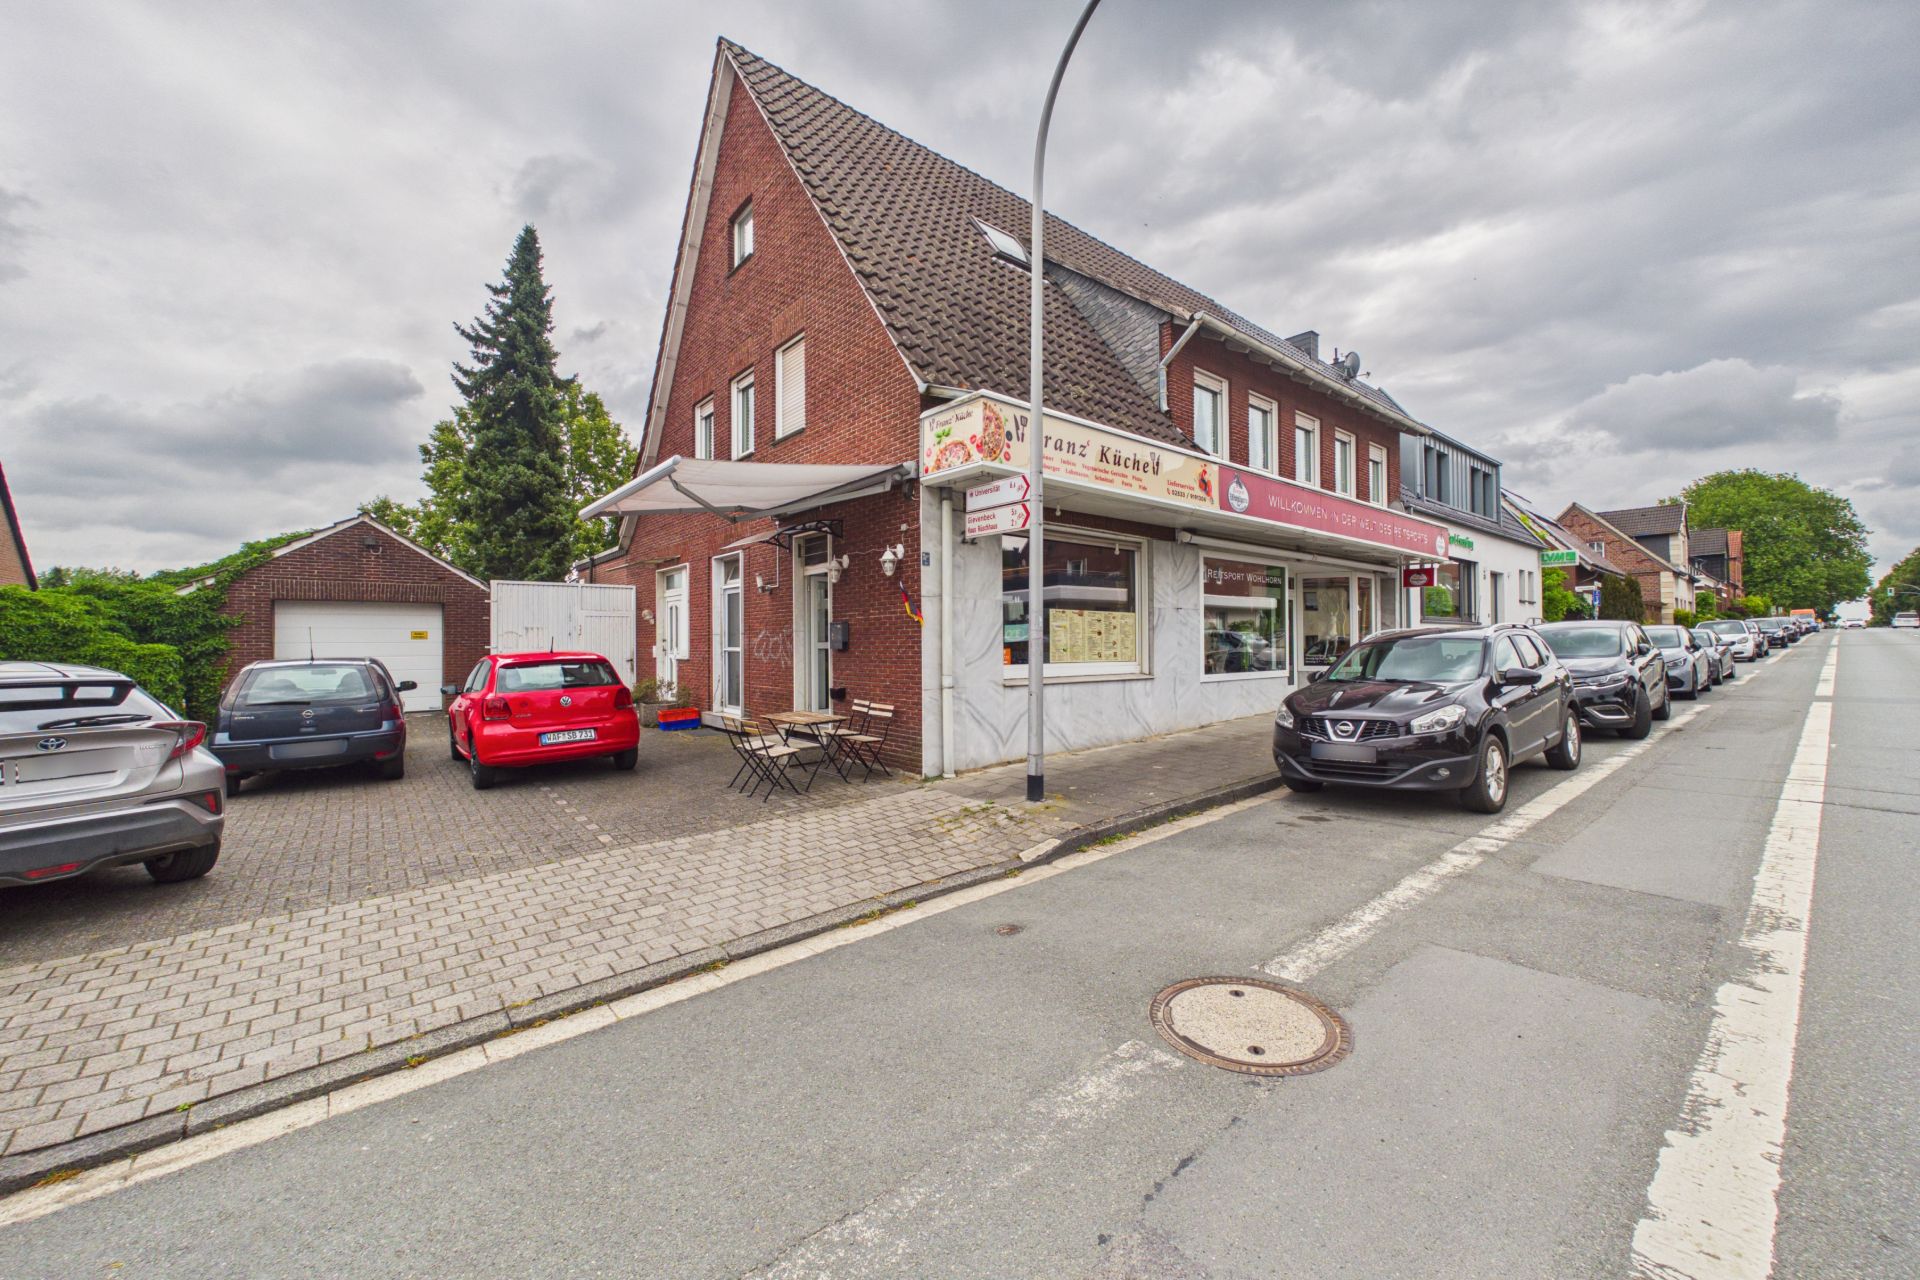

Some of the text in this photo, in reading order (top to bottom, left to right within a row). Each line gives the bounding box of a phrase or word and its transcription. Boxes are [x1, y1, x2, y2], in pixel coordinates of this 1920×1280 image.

[1043, 435, 1149, 474] ranz' Küche
[974, 485, 1001, 497] Universität
[1167, 480, 1195, 491] Lieferservice
[967, 513, 996, 524] Gievenbeck
[1268, 494, 1328, 520] WILLKOMMEN
[1341, 512, 1357, 527] DER
[1379, 522, 1392, 536] DES
[547, 729, 593, 743] WAF SB 731
